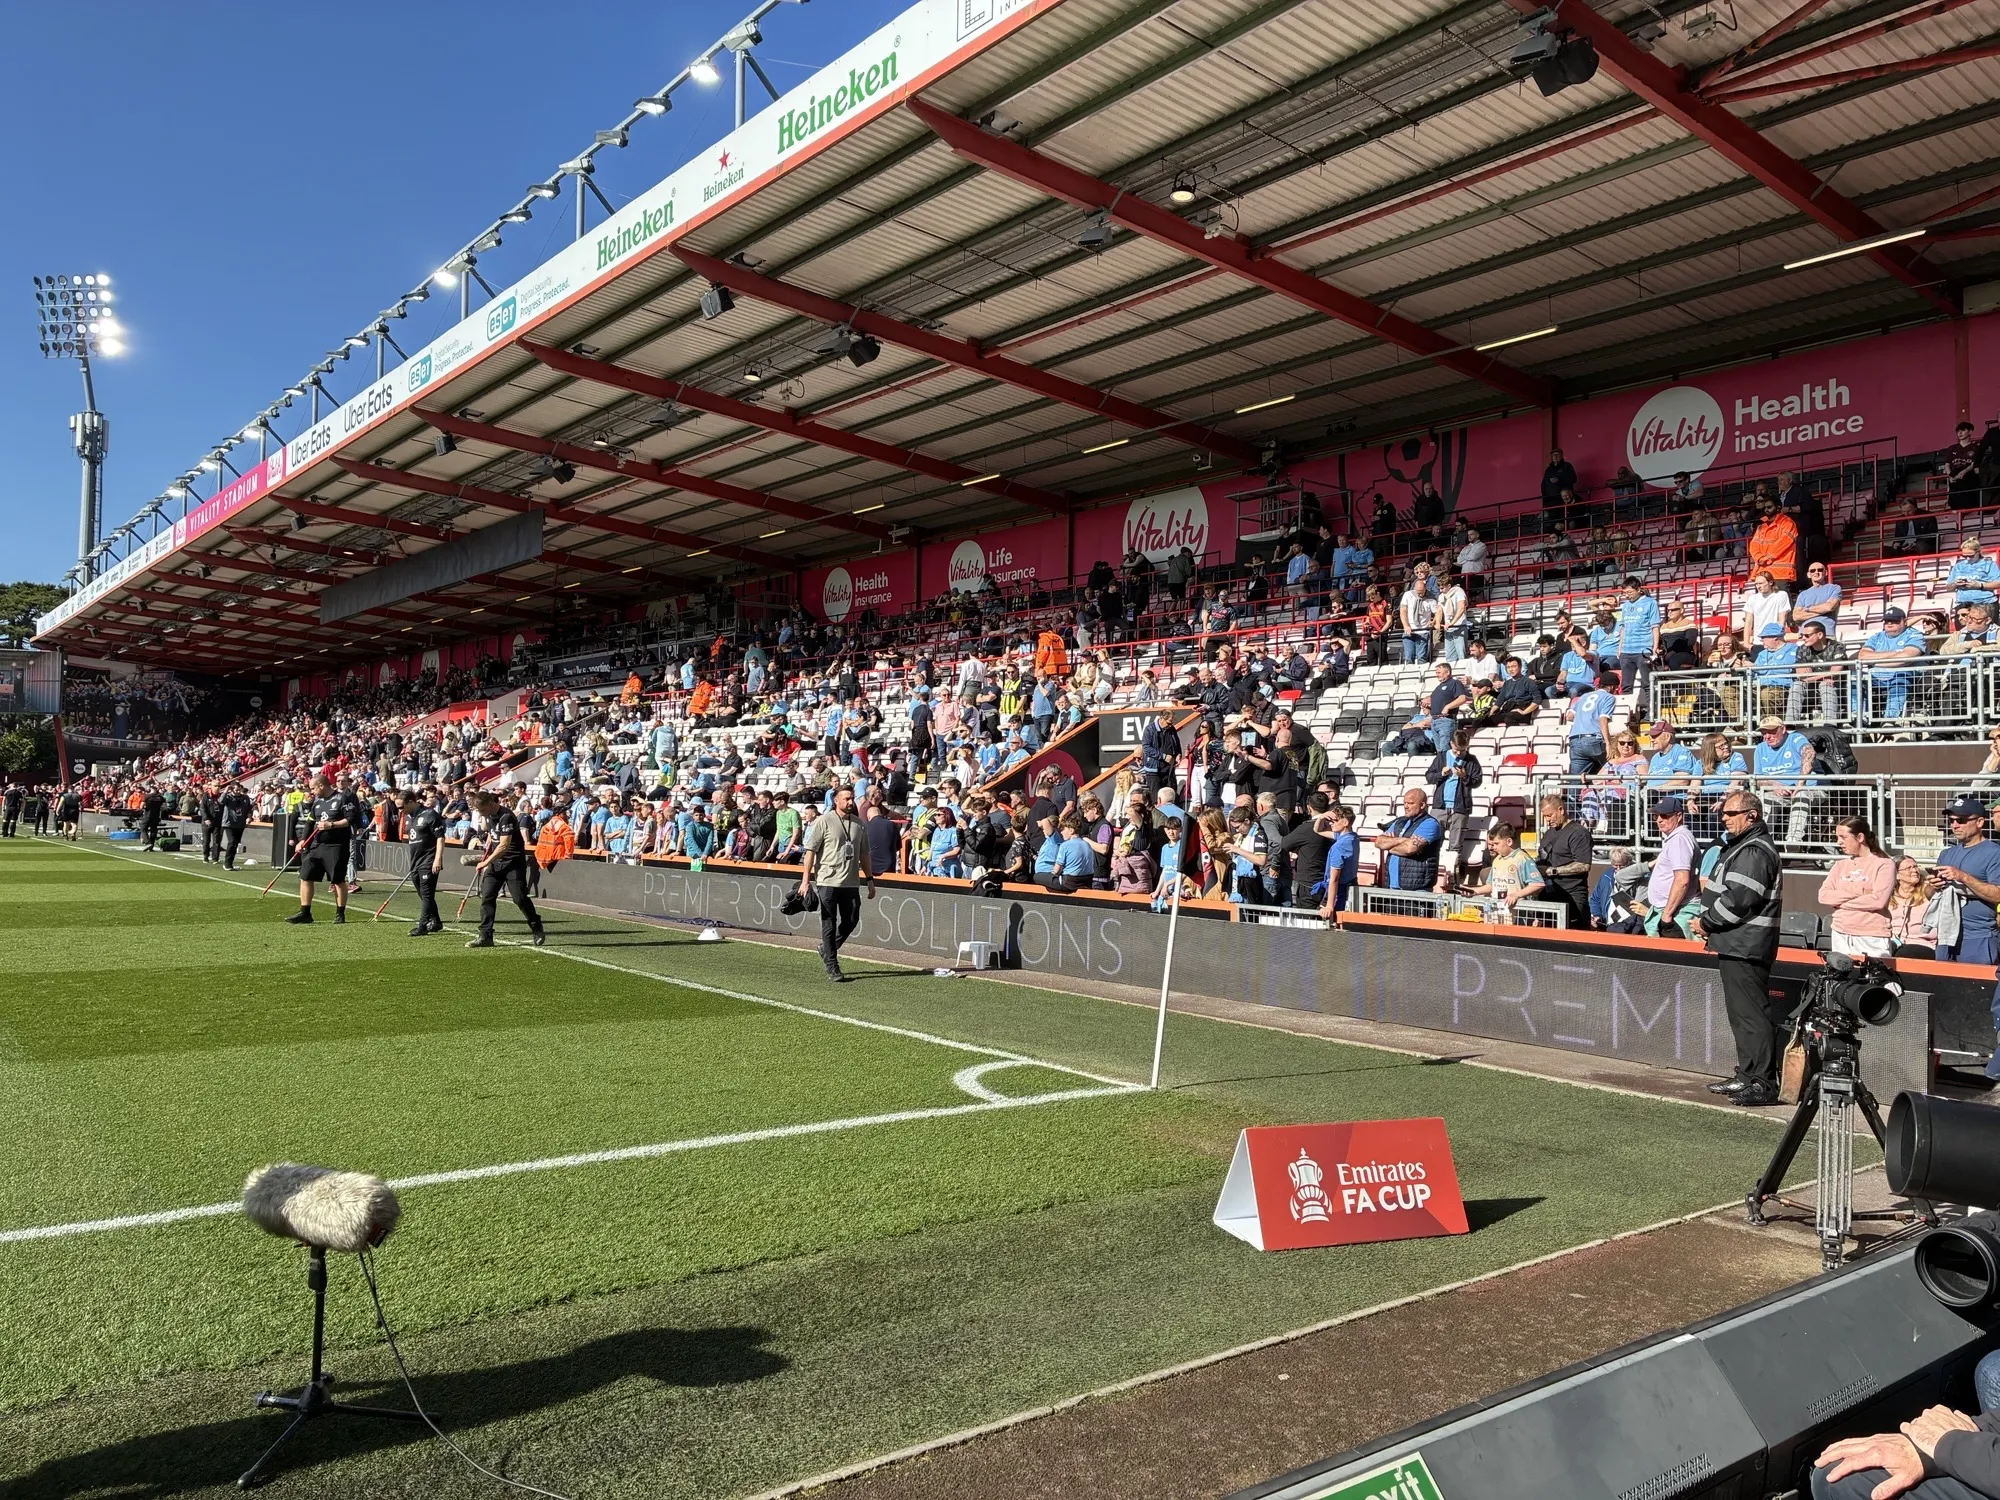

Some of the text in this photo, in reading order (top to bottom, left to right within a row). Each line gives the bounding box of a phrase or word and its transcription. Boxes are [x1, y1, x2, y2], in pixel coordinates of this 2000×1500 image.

[777, 51, 899, 155] Heineken
[703, 167, 744, 202] Heineken
[596, 199, 675, 271] Heineken
[343, 383, 393, 433] Uber Eats
[1734, 378, 1850, 426] Health
[291, 424, 331, 468] Uber Eats
[1631, 415, 1721, 457] Vitality
[1734, 414, 1864, 453] insurance
[190, 498, 221, 533] VITALITY
[223, 473, 258, 511] STADIUM
[1127, 506, 1204, 555] Vitality
[950, 557, 984, 586] Vitality
[989, 547, 1012, 568] Life
[824, 582, 851, 607] Vitality
[854, 591, 892, 607] insurance
[855, 571, 889, 593] Health
[1582, 694, 1598, 711] 8
[1122, 715, 1159, 742] EV
[358, 842, 411, 873] SOLUTION
[876, 895, 1122, 975] SOLUTIONS
[1453, 953, 1712, 1065] PREMI
[1336, 1160, 1426, 1186] Emirates
[1342, 1183, 1431, 1215] FA CUP
